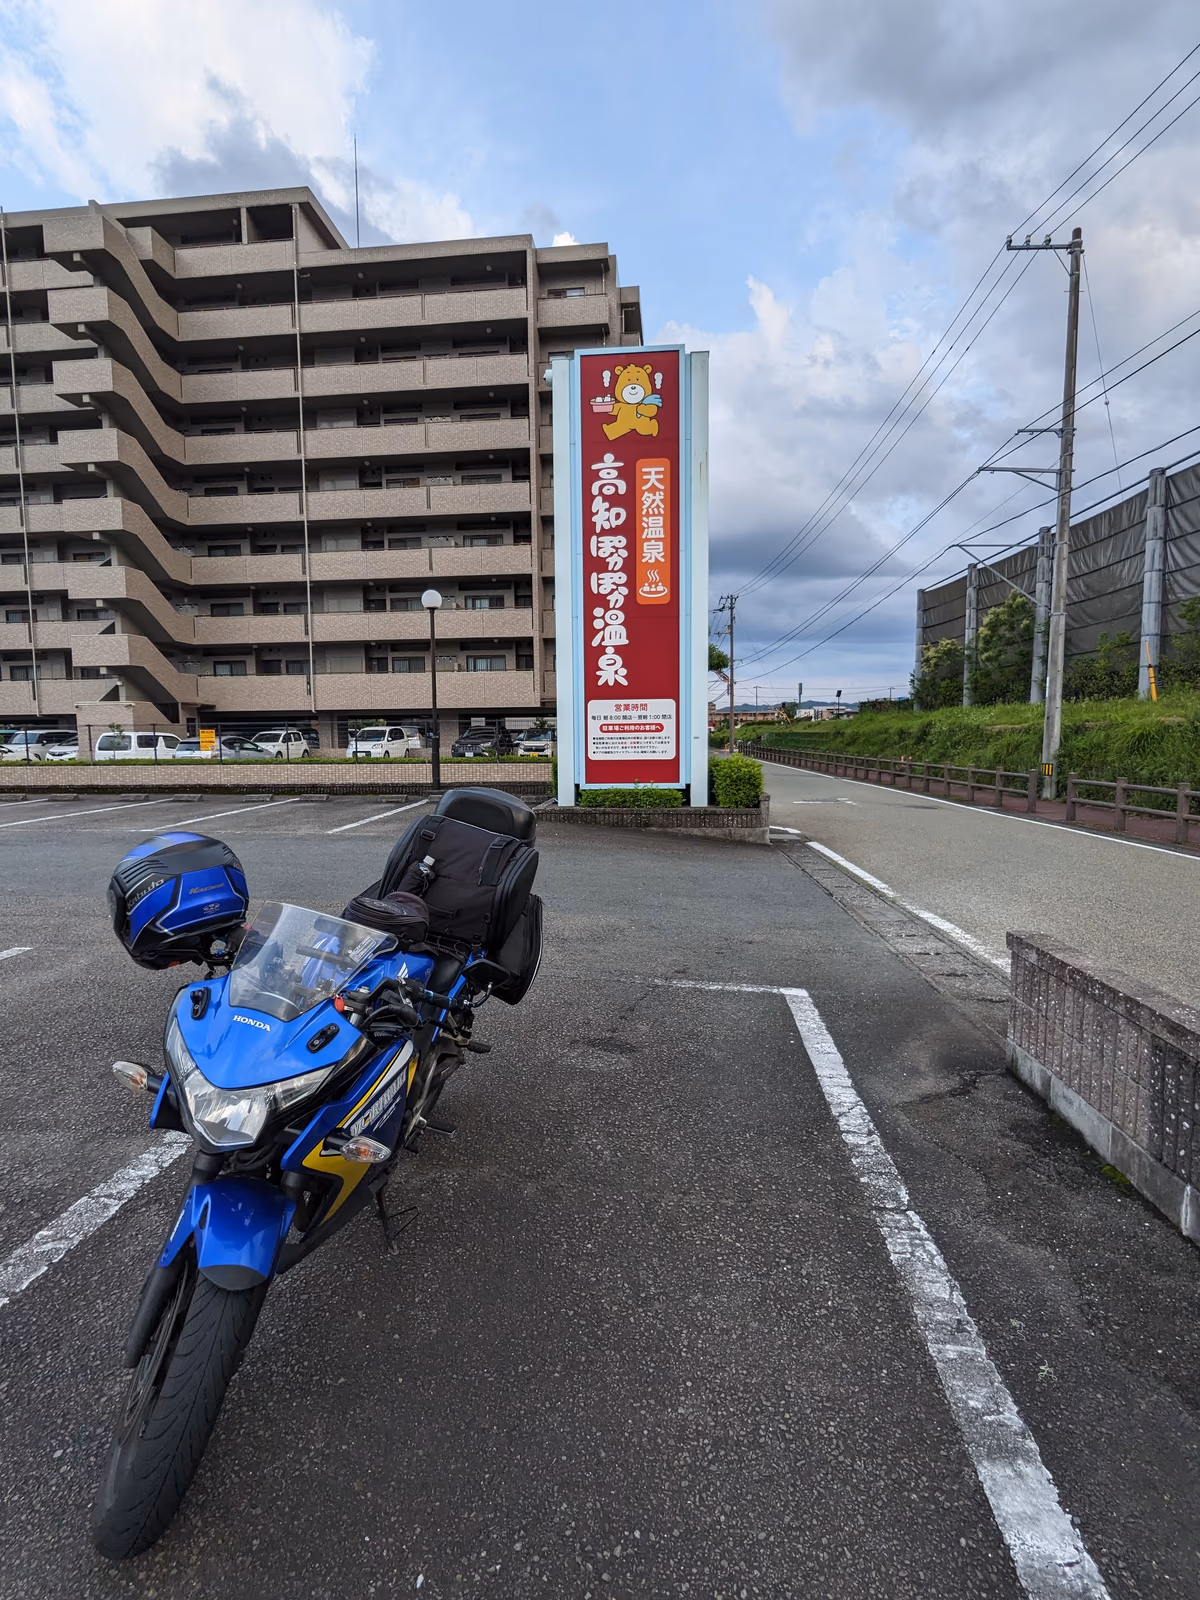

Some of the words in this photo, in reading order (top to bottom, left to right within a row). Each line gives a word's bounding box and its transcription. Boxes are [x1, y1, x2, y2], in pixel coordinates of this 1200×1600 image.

[641, 466, 665, 563] 天然温泉
[590, 453, 629, 686] 高知ぽかぽか温泉
[614, 703, 648, 712] 営業時間
[232, 1014, 271, 1032] HONDA
